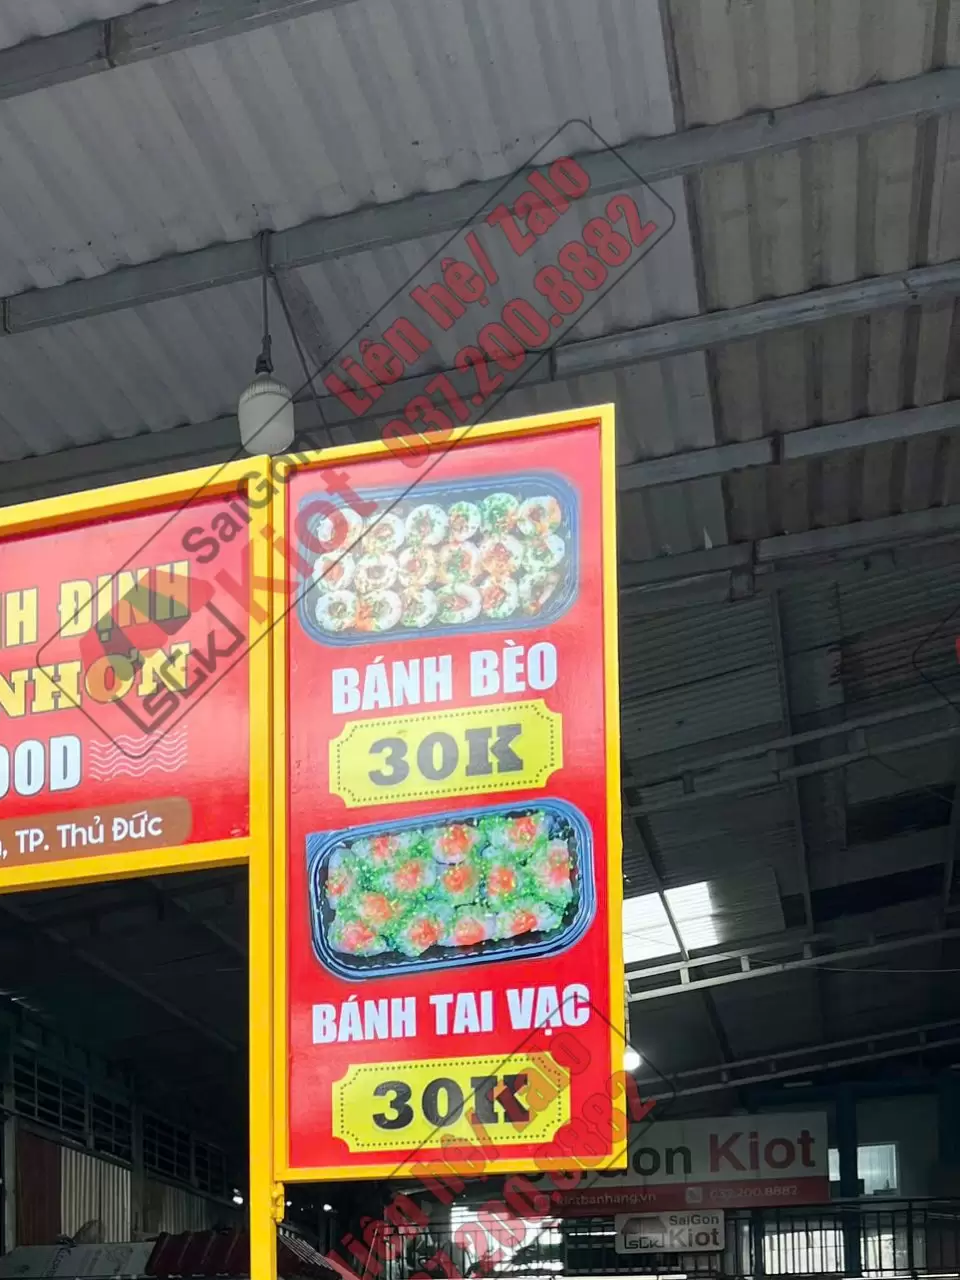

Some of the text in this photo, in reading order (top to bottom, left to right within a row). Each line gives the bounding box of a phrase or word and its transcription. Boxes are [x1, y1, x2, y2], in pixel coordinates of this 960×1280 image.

[57, 560, 190, 642] ĐỊNH
[331, 639, 557, 715] BÁNH BÈO
[367, 723, 524, 786] 30K
[15, 829, 50, 854] TP.
[57, 816, 105, 846] Thủ
[112, 810, 163, 841] Đức
[311, 983, 591, 1044] BÁNH TAI VẠC
[372, 1073, 531, 1130] 30K
[708, 1129, 816, 1173] Kiot
[669, 1226, 720, 1248] Kiot
